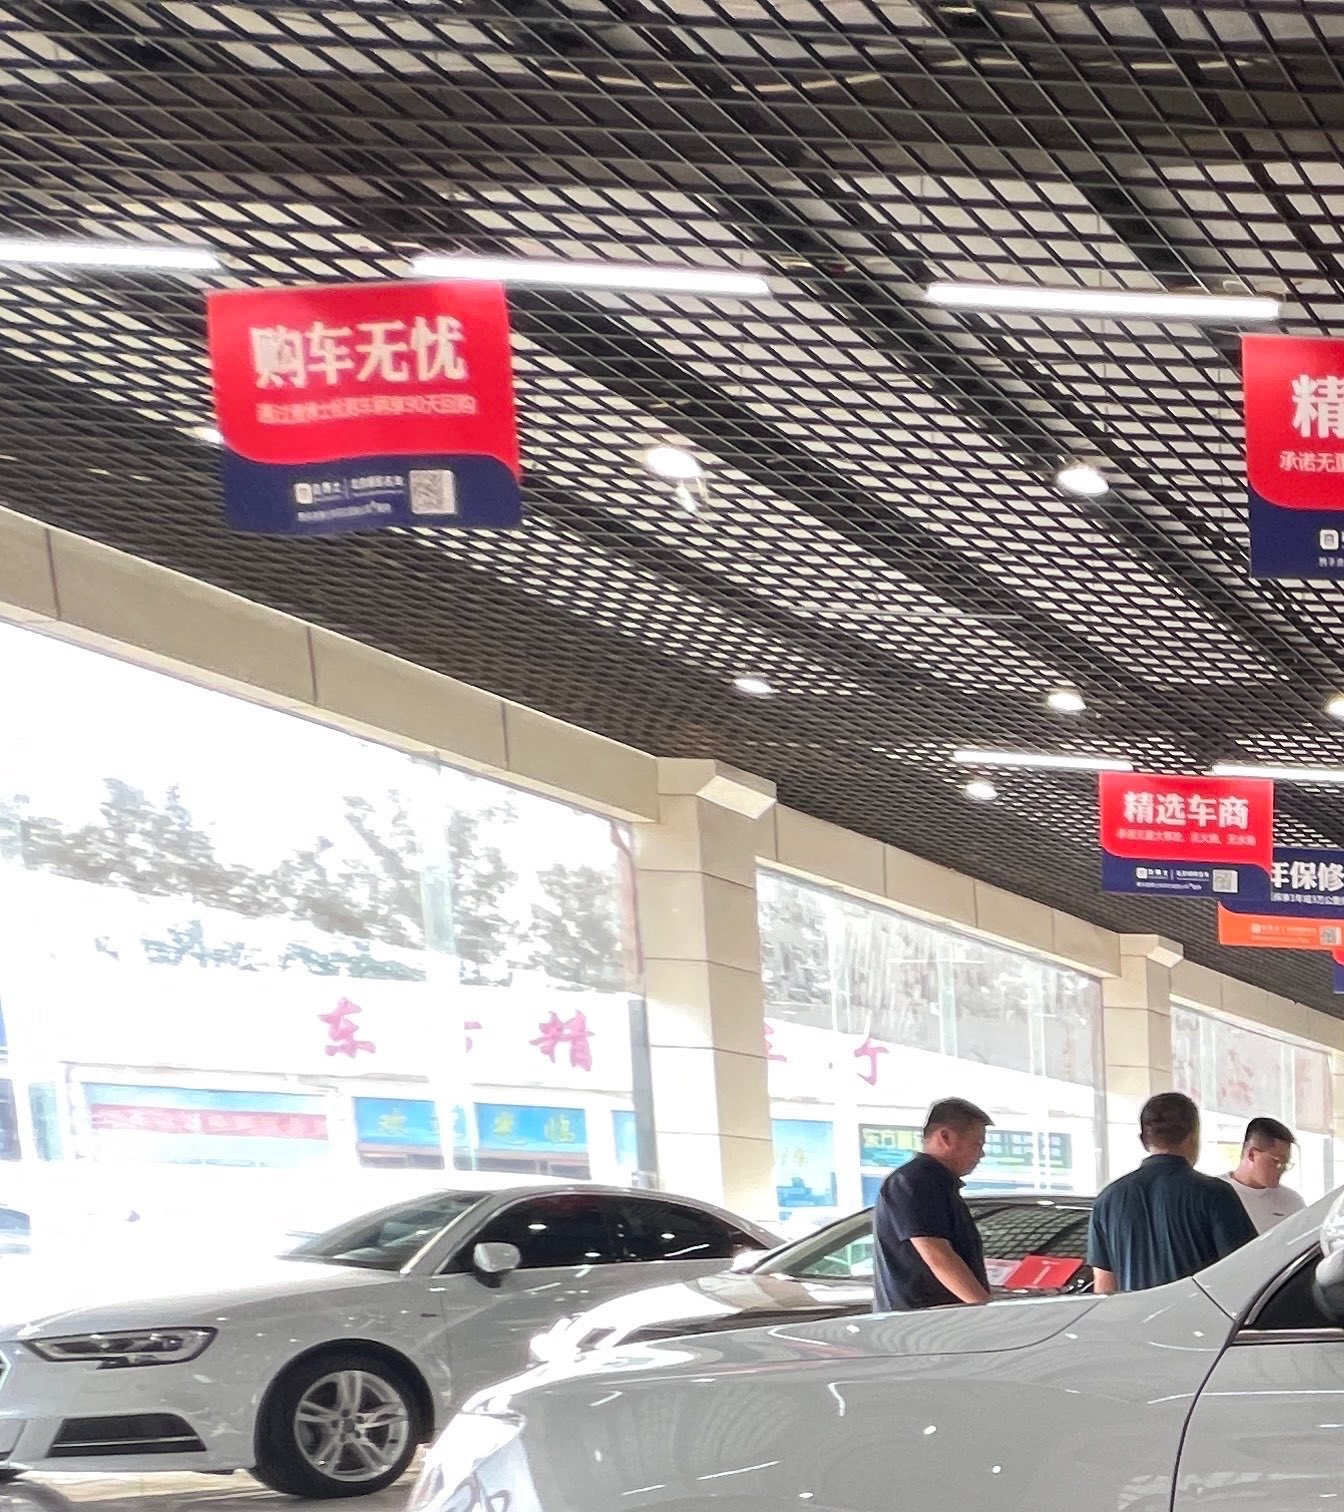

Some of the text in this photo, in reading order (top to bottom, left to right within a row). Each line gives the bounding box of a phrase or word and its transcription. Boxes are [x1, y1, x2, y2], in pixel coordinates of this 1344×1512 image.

[249, 315, 469, 389] 购车无忧
[1123, 790, 1250, 830] 精选车商
